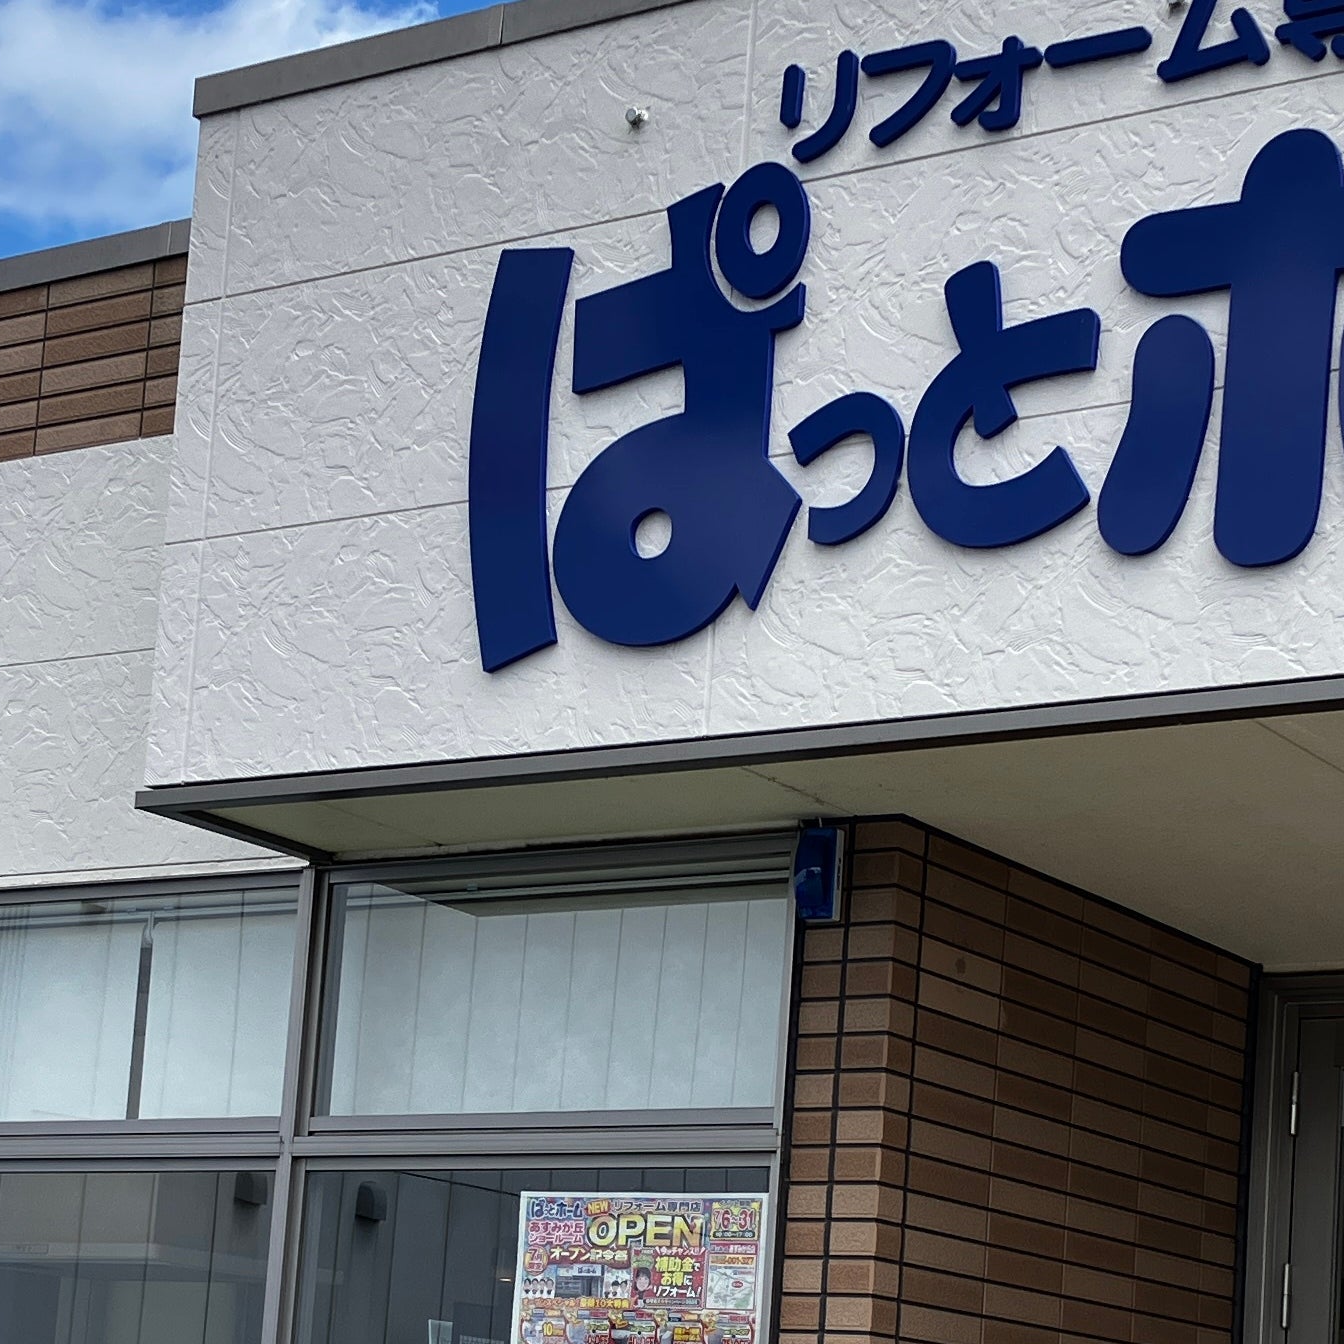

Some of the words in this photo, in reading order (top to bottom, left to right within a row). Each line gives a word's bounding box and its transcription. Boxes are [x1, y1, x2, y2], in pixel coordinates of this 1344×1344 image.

[587, 1201, 609, 1215] NEW
[613, 1201, 701, 1213] リフォーム専門店
[528, 1221, 585, 1235] あすみが丘
[587, 1213, 705, 1249] OPEN
[655, 1256, 701, 1273] 補助金で
[660, 1272, 693, 1286] お得に
